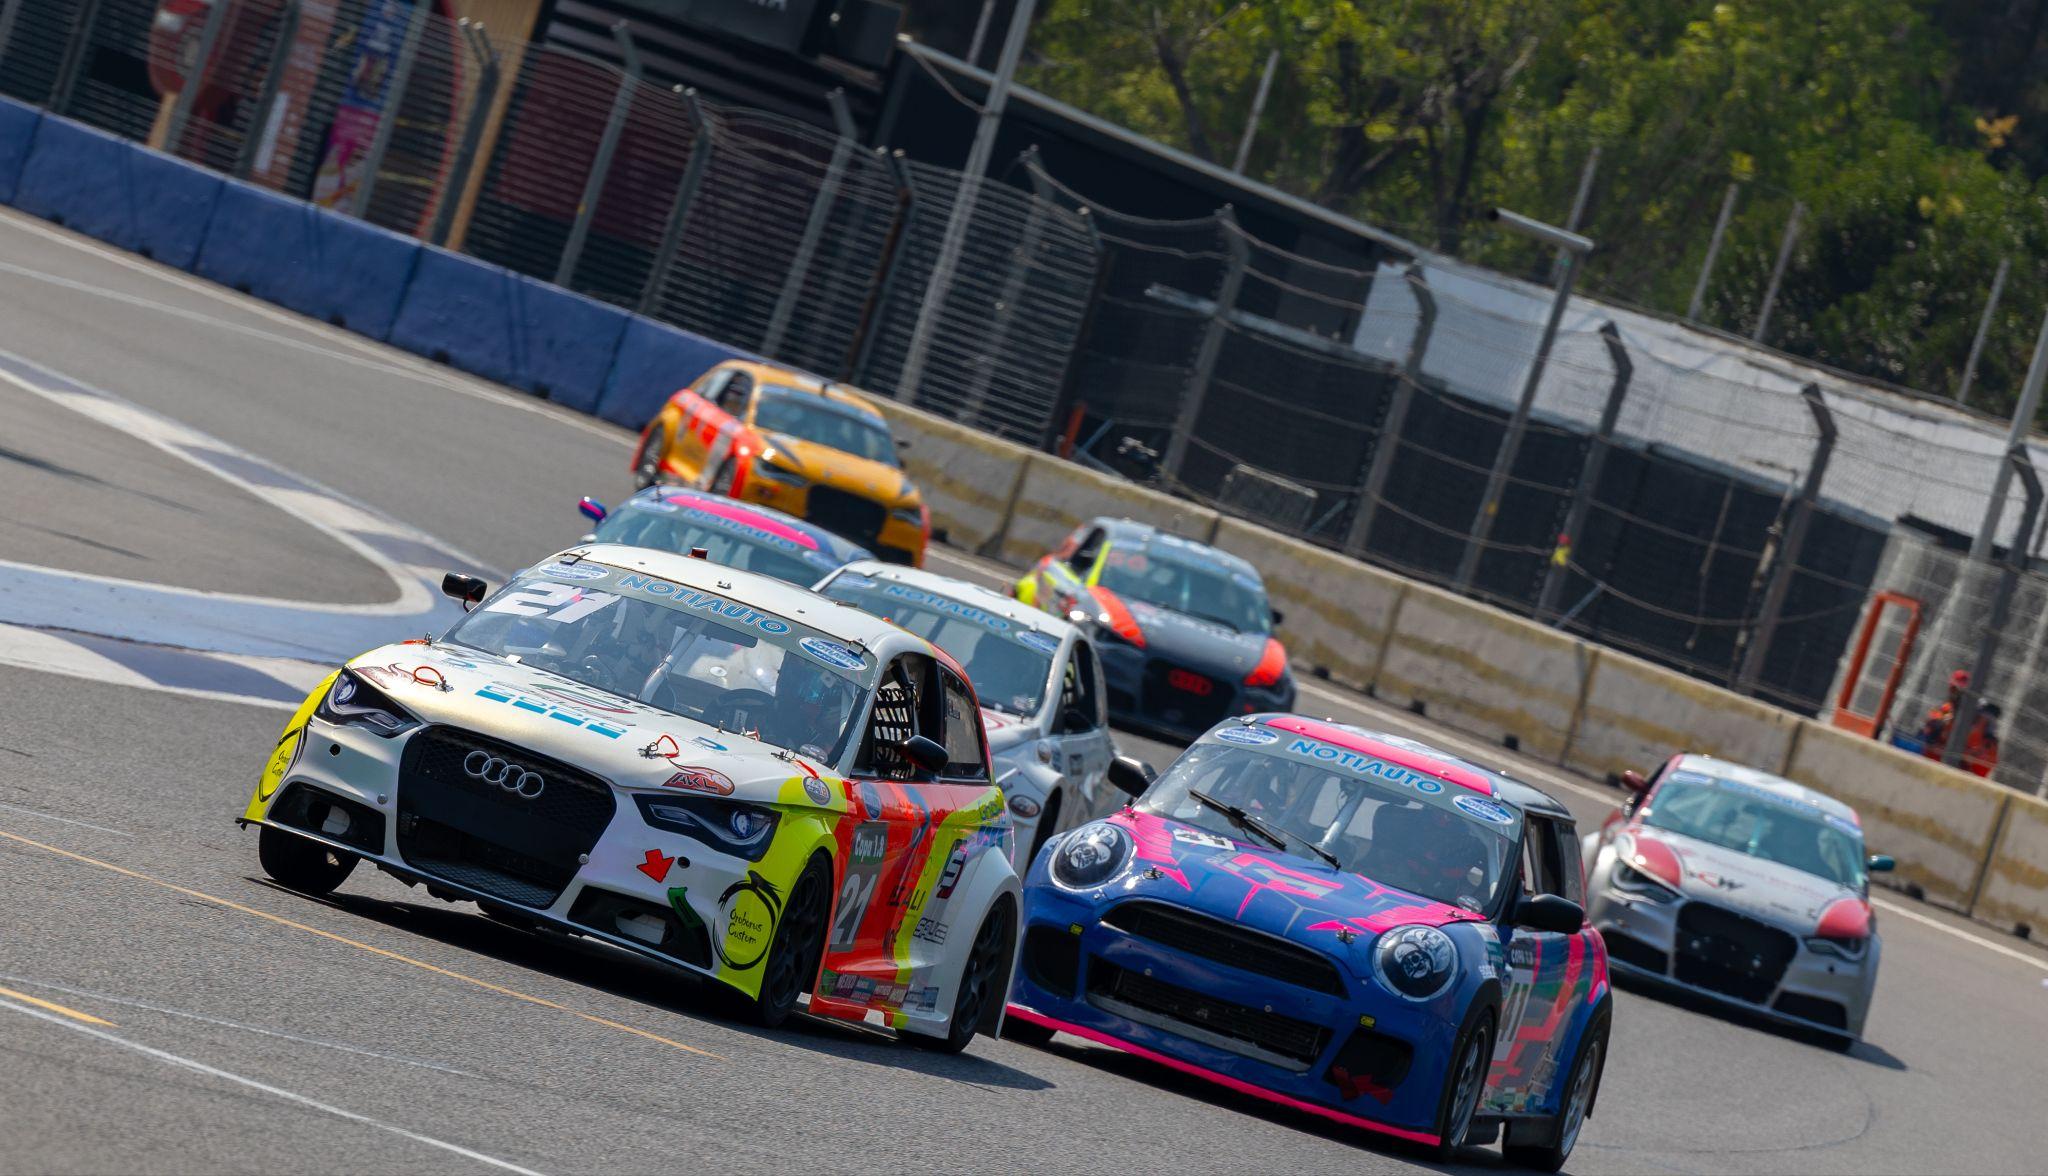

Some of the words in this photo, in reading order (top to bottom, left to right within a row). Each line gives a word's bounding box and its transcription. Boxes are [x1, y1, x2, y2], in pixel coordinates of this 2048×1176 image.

[683, 508, 798, 551] NOTIAUTO
[484, 581, 622, 624] 21
[617, 573, 792, 635] NOTIAUTO
[883, 584, 1011, 631] NOTIAUTO
[669, 774, 718, 790] AKL
[1285, 738, 1445, 795] NOTIAUTO
[855, 832, 873, 862] Copa
[873, 834, 885, 858] 1.8
[830, 873, 877, 945] 21
[728, 922, 757, 945] Custom
